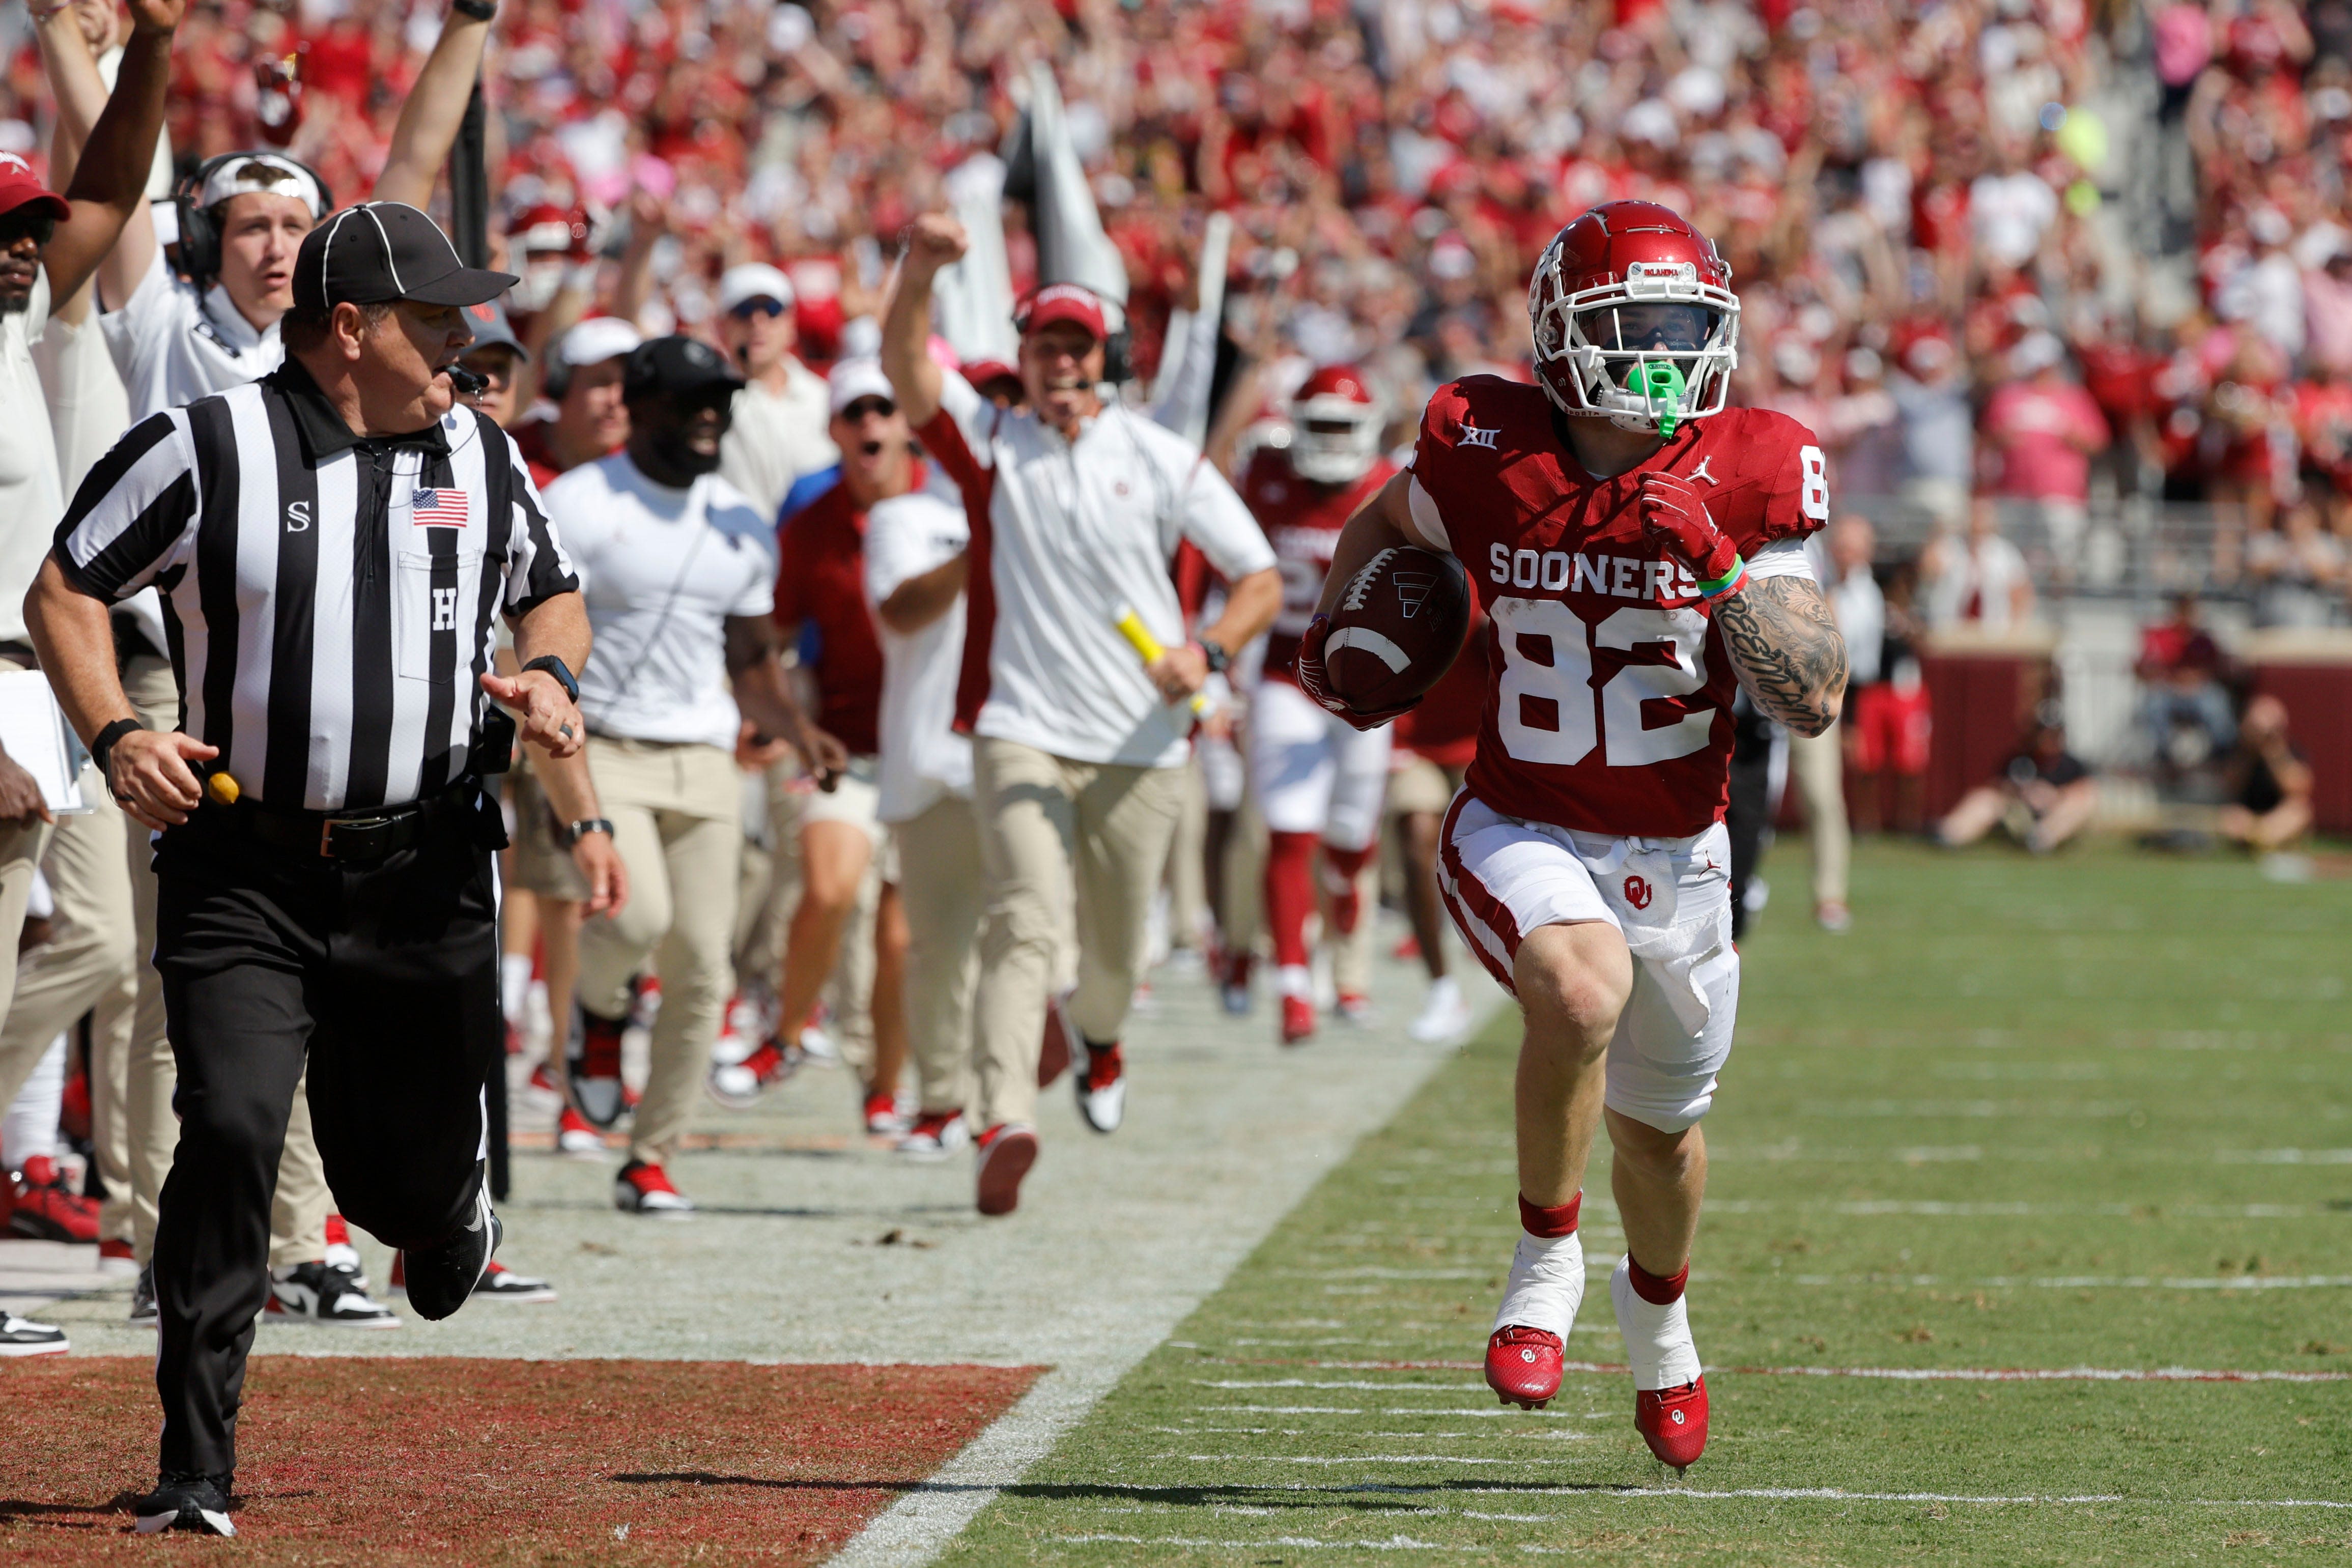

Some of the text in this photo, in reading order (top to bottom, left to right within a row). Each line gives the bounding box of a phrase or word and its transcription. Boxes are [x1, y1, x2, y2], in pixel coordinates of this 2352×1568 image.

[1457, 422, 1501, 450] XII
[1490, 541, 1702, 600] SOONERS
[433, 587, 457, 631] H
[1723, 587, 1738, 600] OTHER
[1716, 593, 1821, 723] REEMAN
[1489, 594, 1717, 767] 82
[1623, 875, 1652, 910] OU
[1521, 1349, 1536, 1363] OU
[1671, 1409, 1685, 1425] OU
